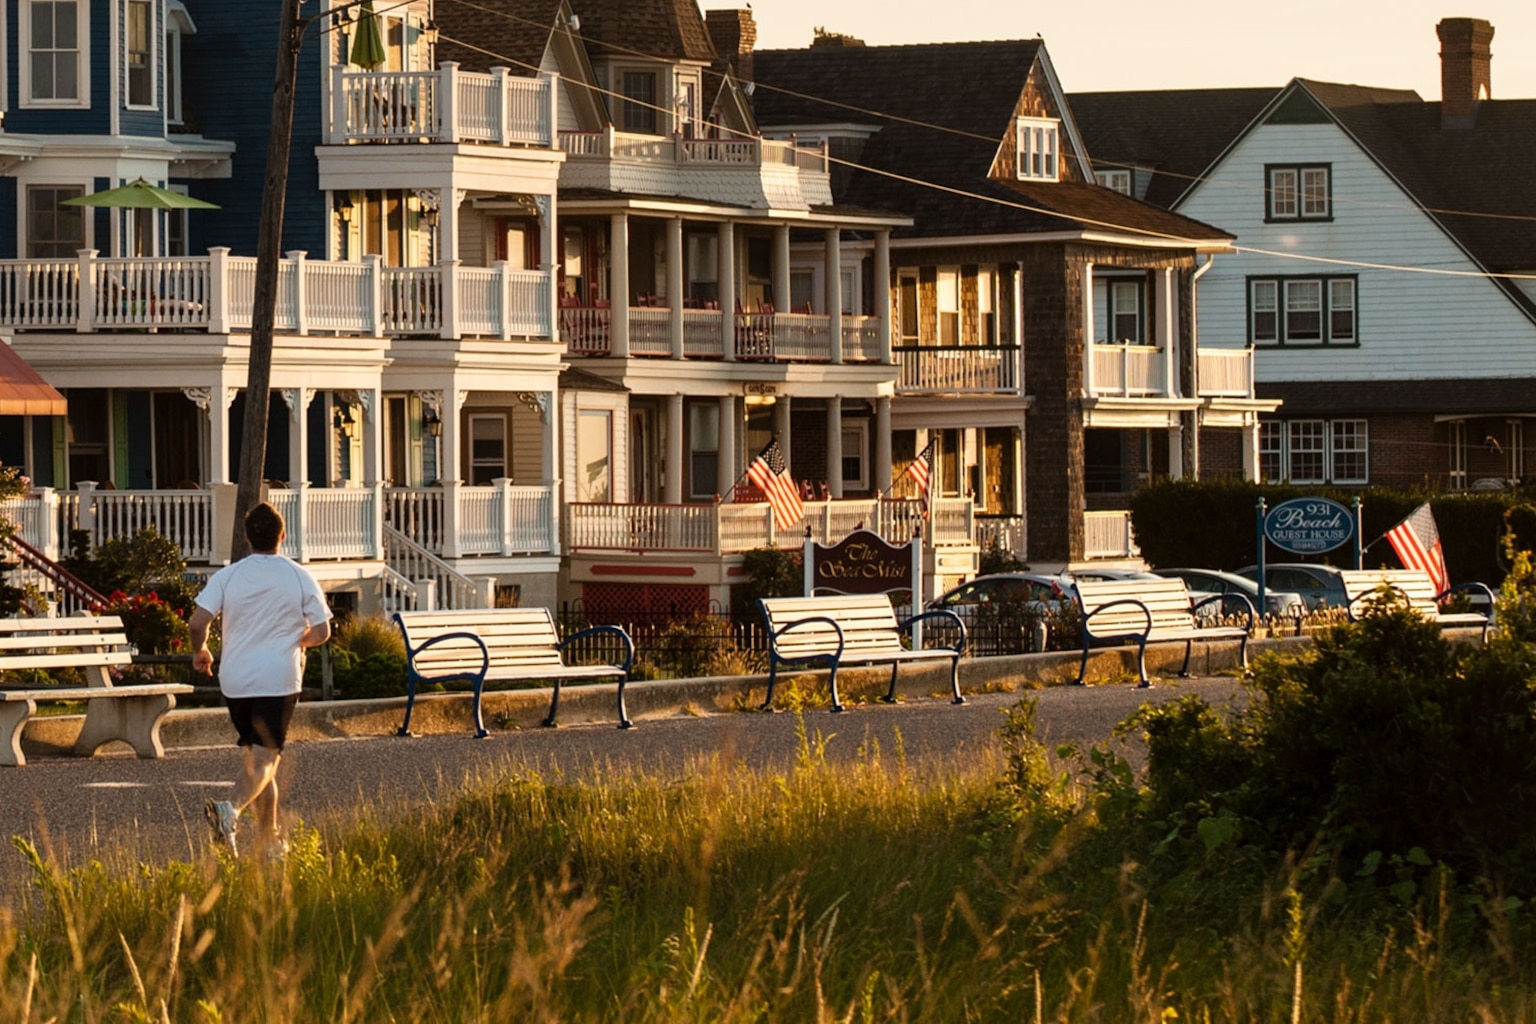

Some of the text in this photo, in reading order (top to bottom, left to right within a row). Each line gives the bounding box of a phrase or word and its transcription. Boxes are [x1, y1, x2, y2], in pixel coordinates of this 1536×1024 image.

[1275, 508, 1342, 528] Beach
[1307, 504, 1330, 515] 931
[1273, 530, 1345, 539] GUEST HOUSE
[845, 543, 878, 560] The
[819, 560, 906, 578] Sea Mist
